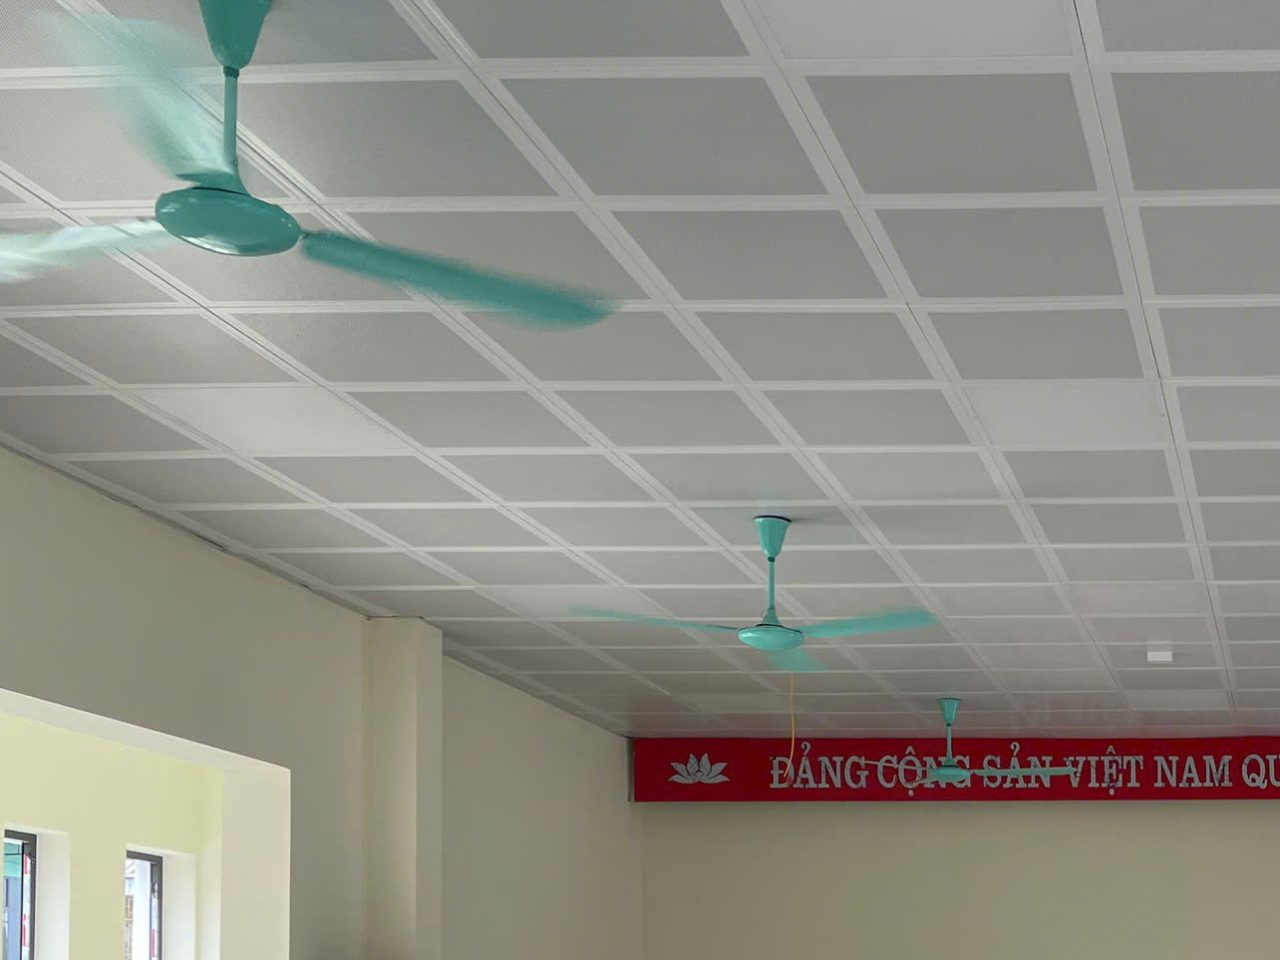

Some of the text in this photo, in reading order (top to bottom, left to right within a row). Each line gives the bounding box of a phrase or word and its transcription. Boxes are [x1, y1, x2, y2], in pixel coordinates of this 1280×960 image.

[769, 741, 869, 788] ĐẢNG
[982, 741, 1053, 789] SẢN
[1064, 745, 1144, 796] VIỆT
[1154, 755, 1233, 788] NAM
